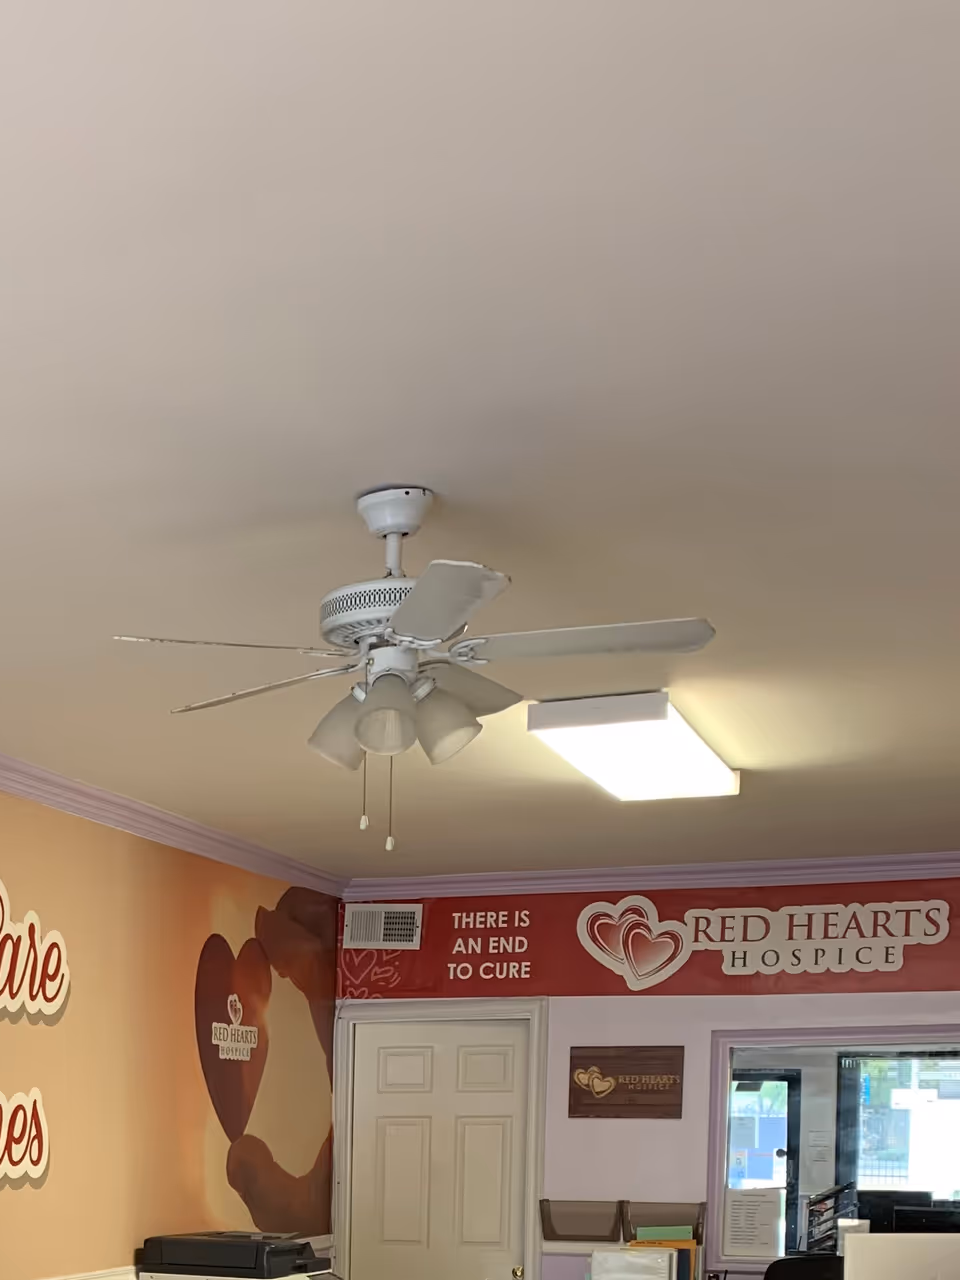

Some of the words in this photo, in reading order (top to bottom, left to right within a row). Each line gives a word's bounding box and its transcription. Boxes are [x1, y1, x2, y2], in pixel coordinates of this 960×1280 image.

[452, 911, 508, 929] THERE
[514, 910, 530, 927] IS
[691, 914, 771, 943] RED
[785, 907, 942, 941] HEARTS
[452, 937, 482, 954] AN
[488, 936, 528, 953] END
[730, 946, 897, 968] HOSPICE
[448, 963, 473, 979] TO
[479, 962, 531, 979] CURE
[213, 1026, 228, 1041] RED
[230, 1028, 256, 1044] HEARTS
[221, 1046, 250, 1057] HOSPICE
[618, 1075, 639, 1083] RED
[642, 1075, 681, 1084] HEARTS
